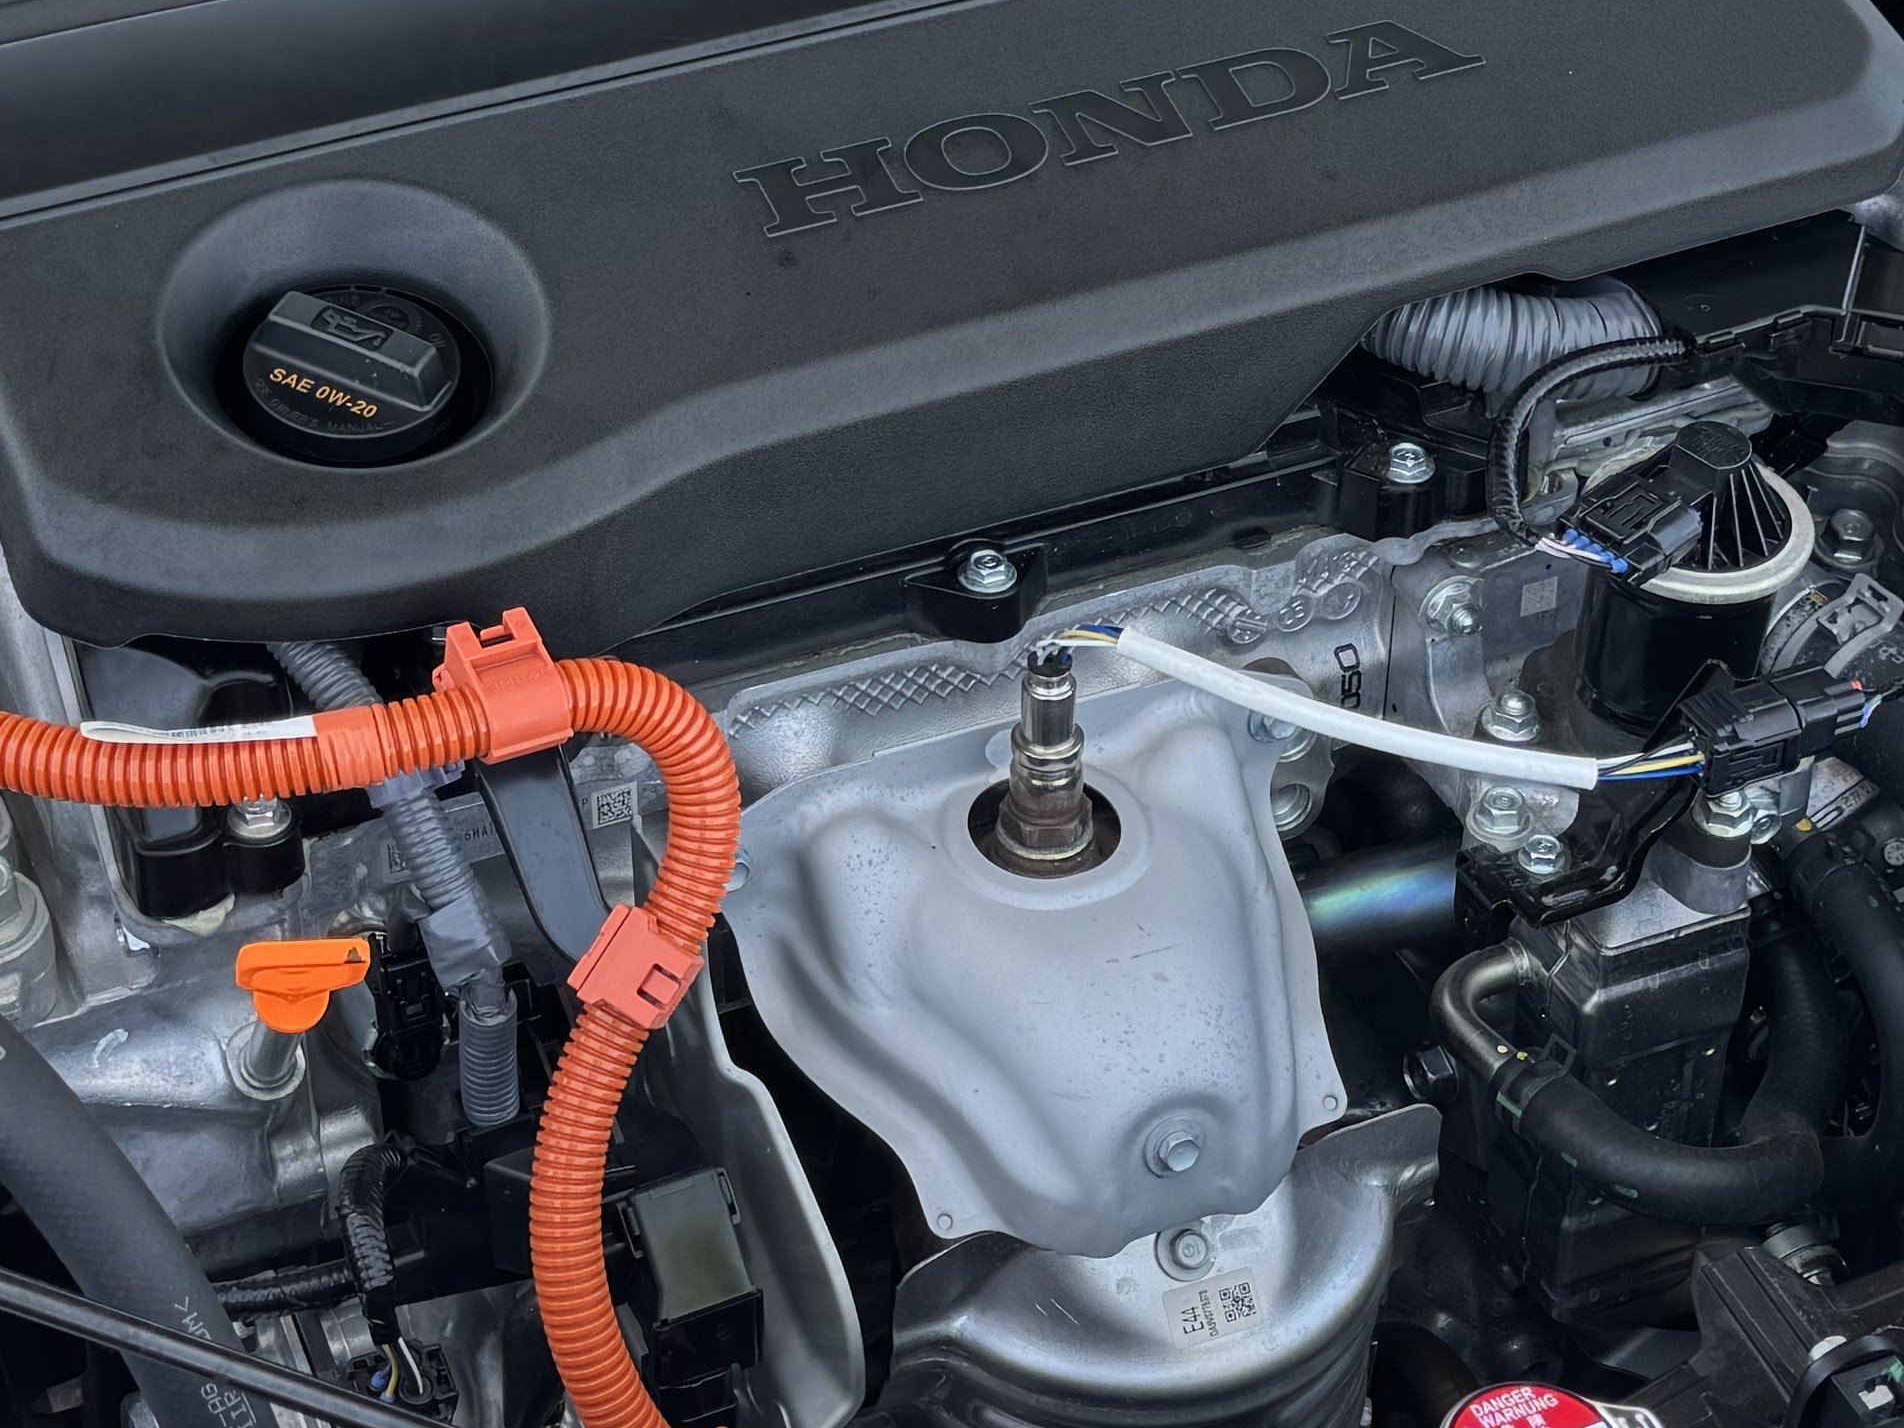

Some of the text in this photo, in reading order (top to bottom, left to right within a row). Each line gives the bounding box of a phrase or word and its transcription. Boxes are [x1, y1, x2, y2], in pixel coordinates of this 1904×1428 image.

[733, 19, 1487, 237] HONDA
[269, 368, 378, 418] SAE 0W-20
[1181, 1306, 1204, 1334] E44
[1469, 1386, 1537, 1418] DANGER
